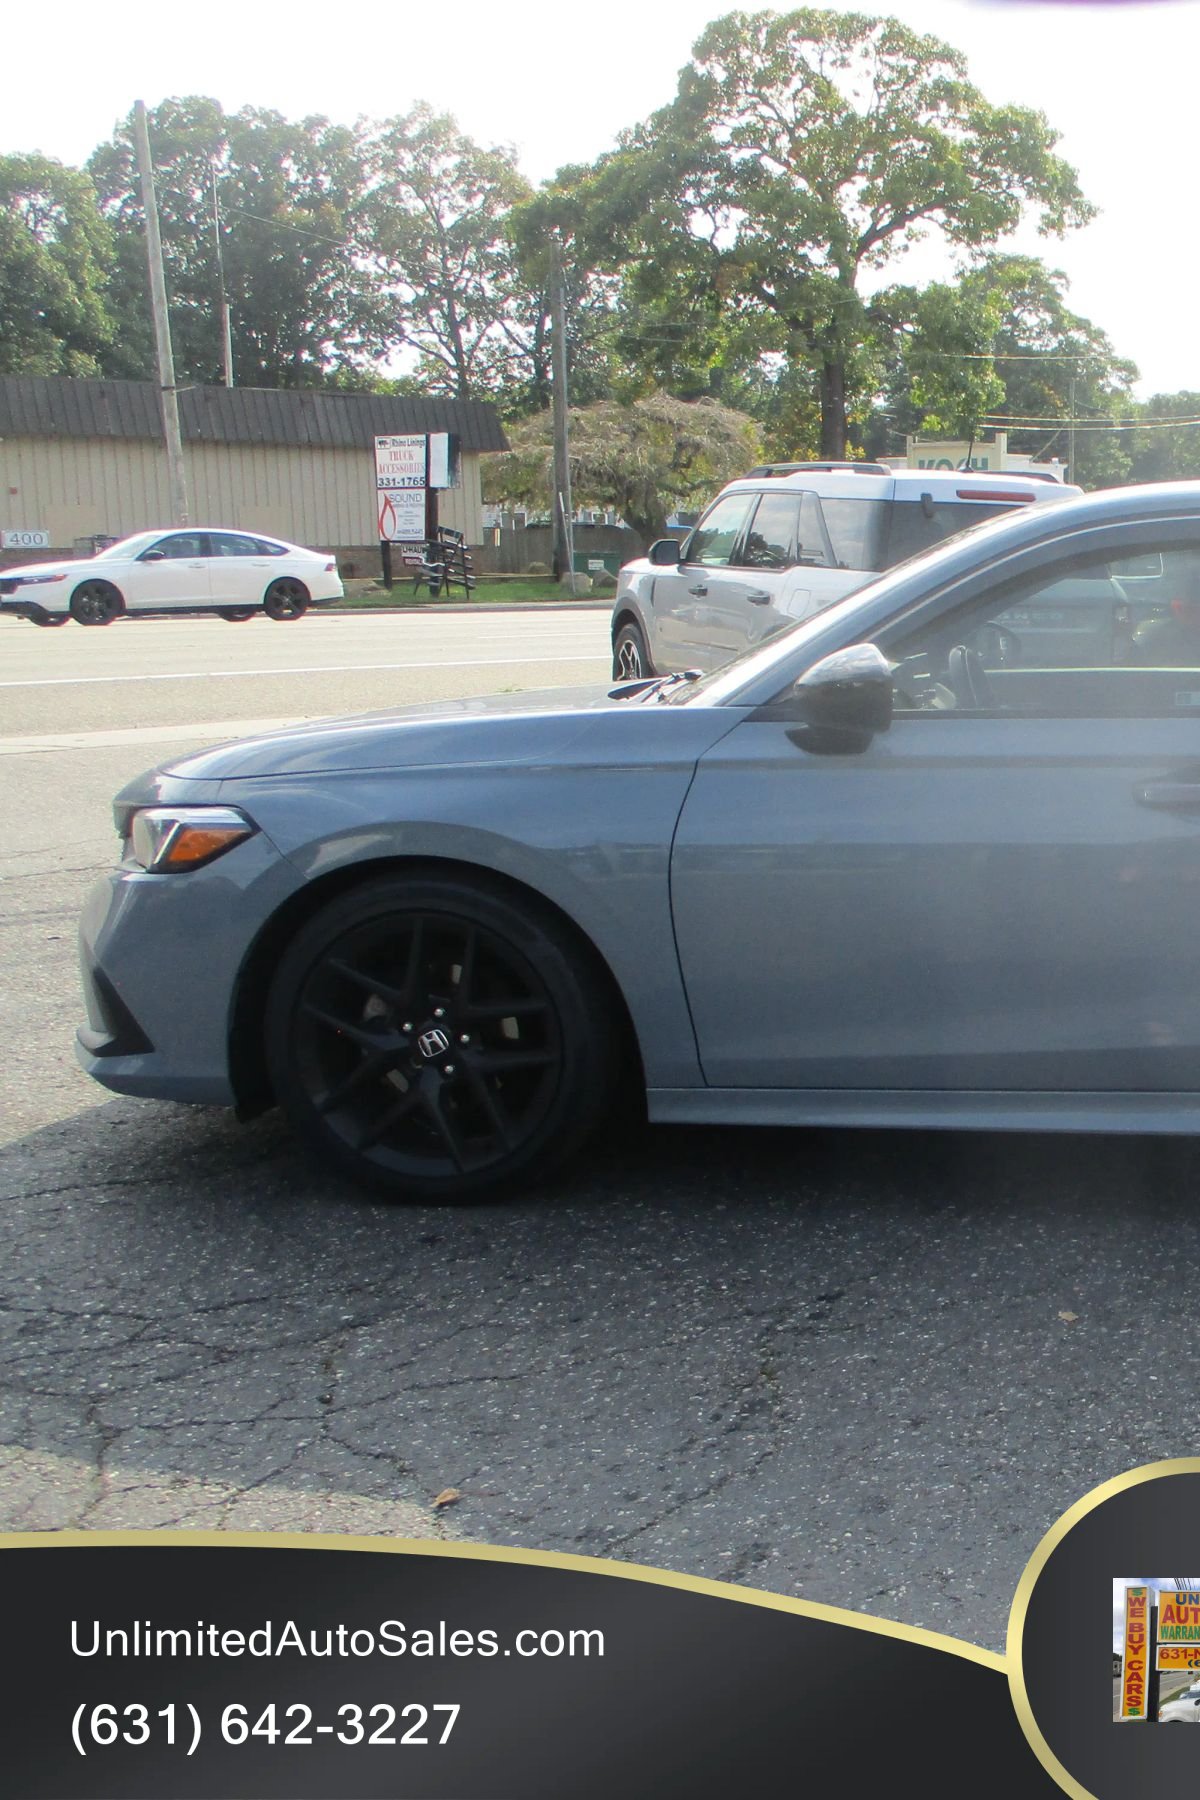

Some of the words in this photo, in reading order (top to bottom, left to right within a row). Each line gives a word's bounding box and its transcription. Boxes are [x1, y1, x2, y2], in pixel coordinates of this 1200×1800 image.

[389, 451, 414, 461] TRUCK
[378, 463, 426, 474] ACCESSORIES
[378, 477, 426, 487] 331-1765
[389, 493, 422, 503] SOUND
[9, 533, 44, 545] 400
